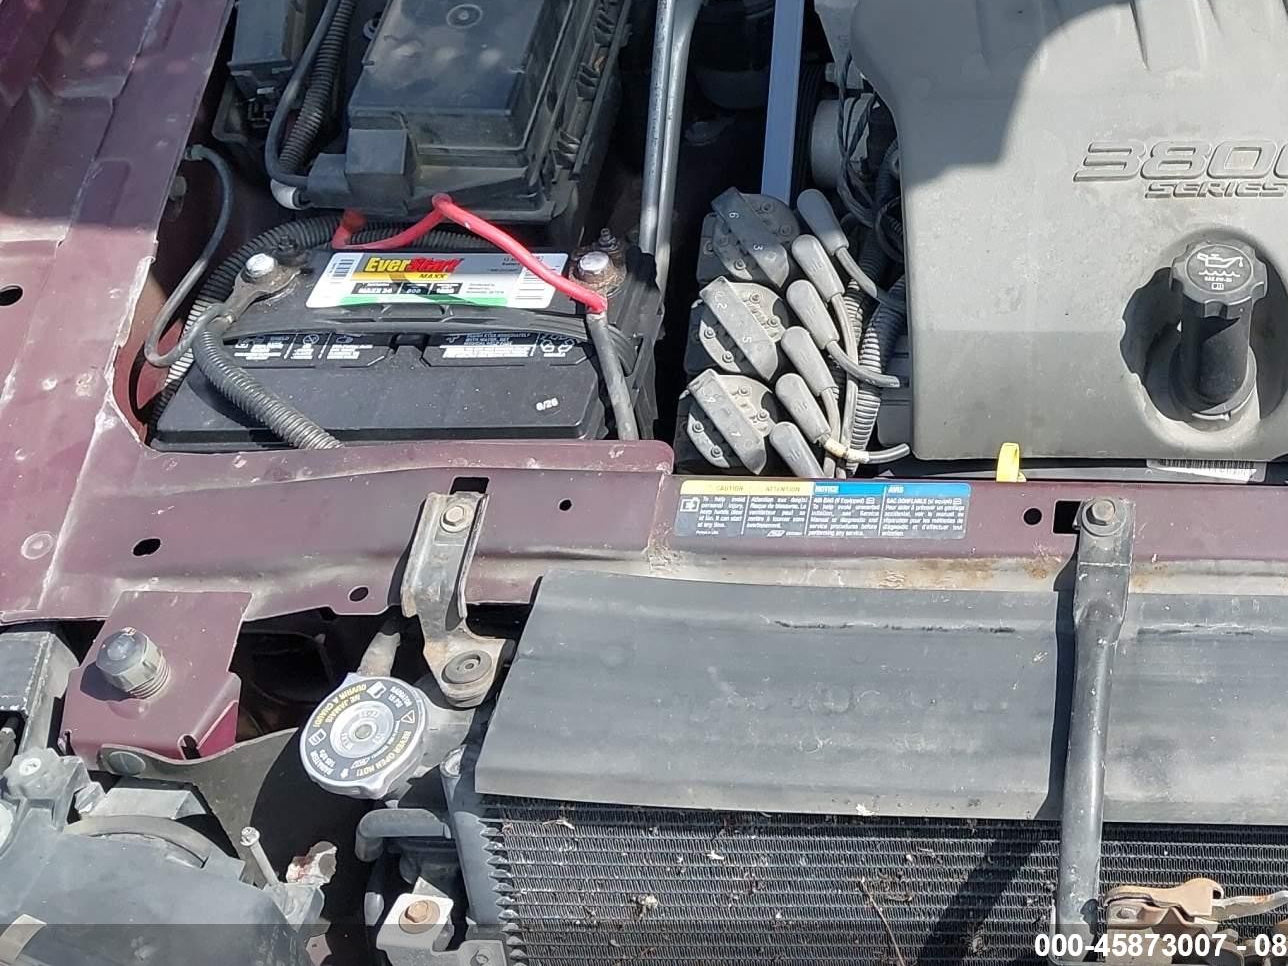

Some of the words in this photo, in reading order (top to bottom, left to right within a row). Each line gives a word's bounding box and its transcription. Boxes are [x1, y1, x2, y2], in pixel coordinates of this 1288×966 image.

[1144, 180, 1288, 200] SERIES
[363, 256, 466, 274] EverStart
[717, 302, 728, 310] 2
[742, 336, 752, 344] 5
[338, 683, 367, 700] OUVRIR
[325, 699, 349, 723] JAMAIS
[393, 730, 413, 754] NEVER
[375, 752, 396, 770] OPEN
[356, 765, 376, 777] HOT!
